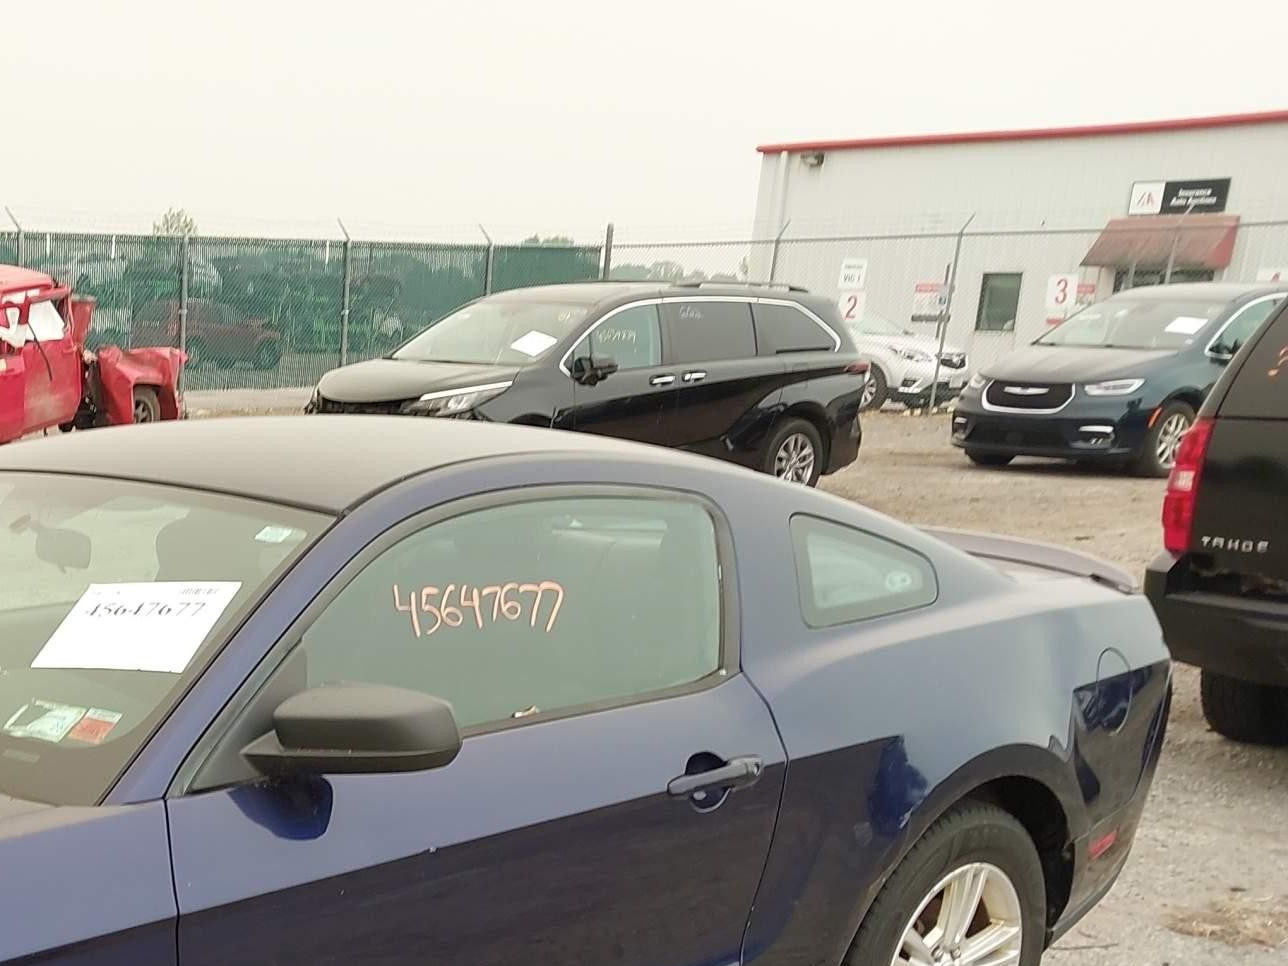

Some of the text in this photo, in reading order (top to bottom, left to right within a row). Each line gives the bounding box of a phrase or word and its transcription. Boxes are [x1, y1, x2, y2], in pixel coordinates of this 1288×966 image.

[1055, 278, 1068, 304] 3
[844, 294, 858, 320] 2
[1201, 535, 1269, 553] TAHOE
[393, 581, 564, 638] 45647677
